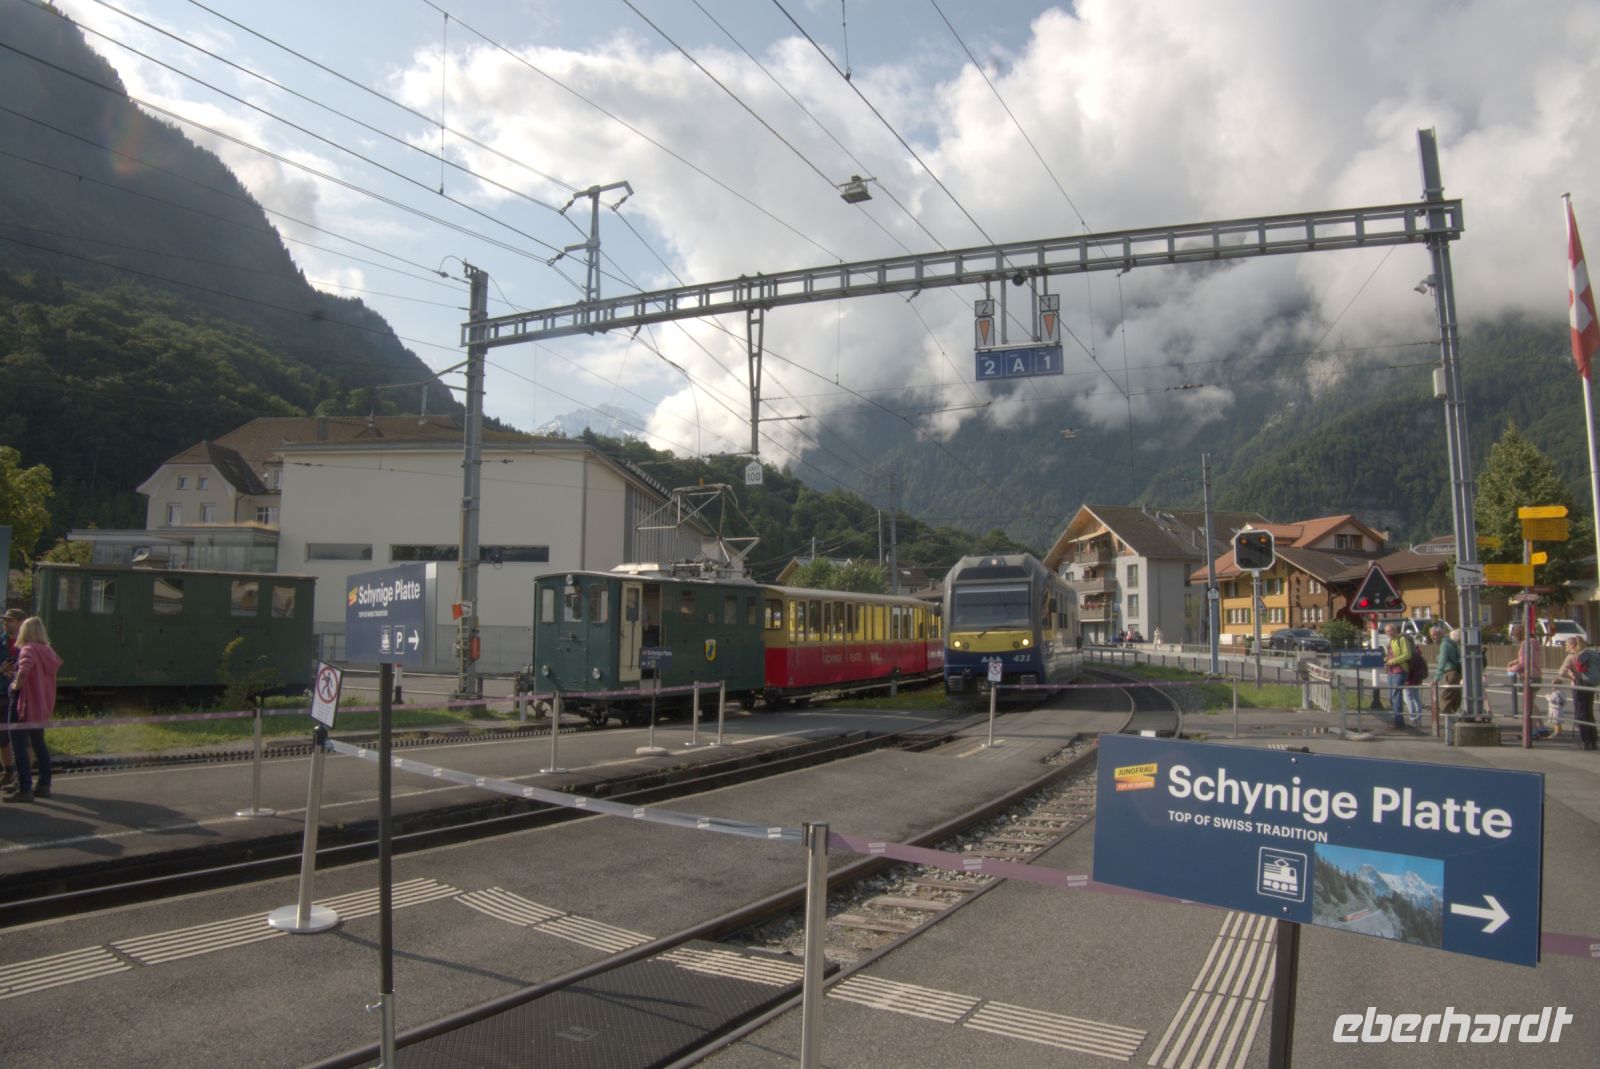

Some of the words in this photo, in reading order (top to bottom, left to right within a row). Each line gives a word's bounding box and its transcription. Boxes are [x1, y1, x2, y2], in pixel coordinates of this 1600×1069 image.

[981, 302, 989, 315] 2
[984, 360, 996, 375] 2
[1012, 358, 1025, 373] A
[1043, 355, 1051, 370] 1
[747, 472, 761, 482] 100
[358, 582, 393, 608] Schynige
[394, 579, 420, 601] Platte
[396, 631, 403, 649] P
[1118, 765, 1154, 776] JUNGFRAU
[1168, 764, 1358, 824] Schynige
[1372, 785, 1513, 839] Platte
[1168, 810, 1192, 823] TOP
[1194, 814, 1211, 826] OF
[1213, 817, 1253, 832] SWISS
[1255, 822, 1328, 843] TRADITION
